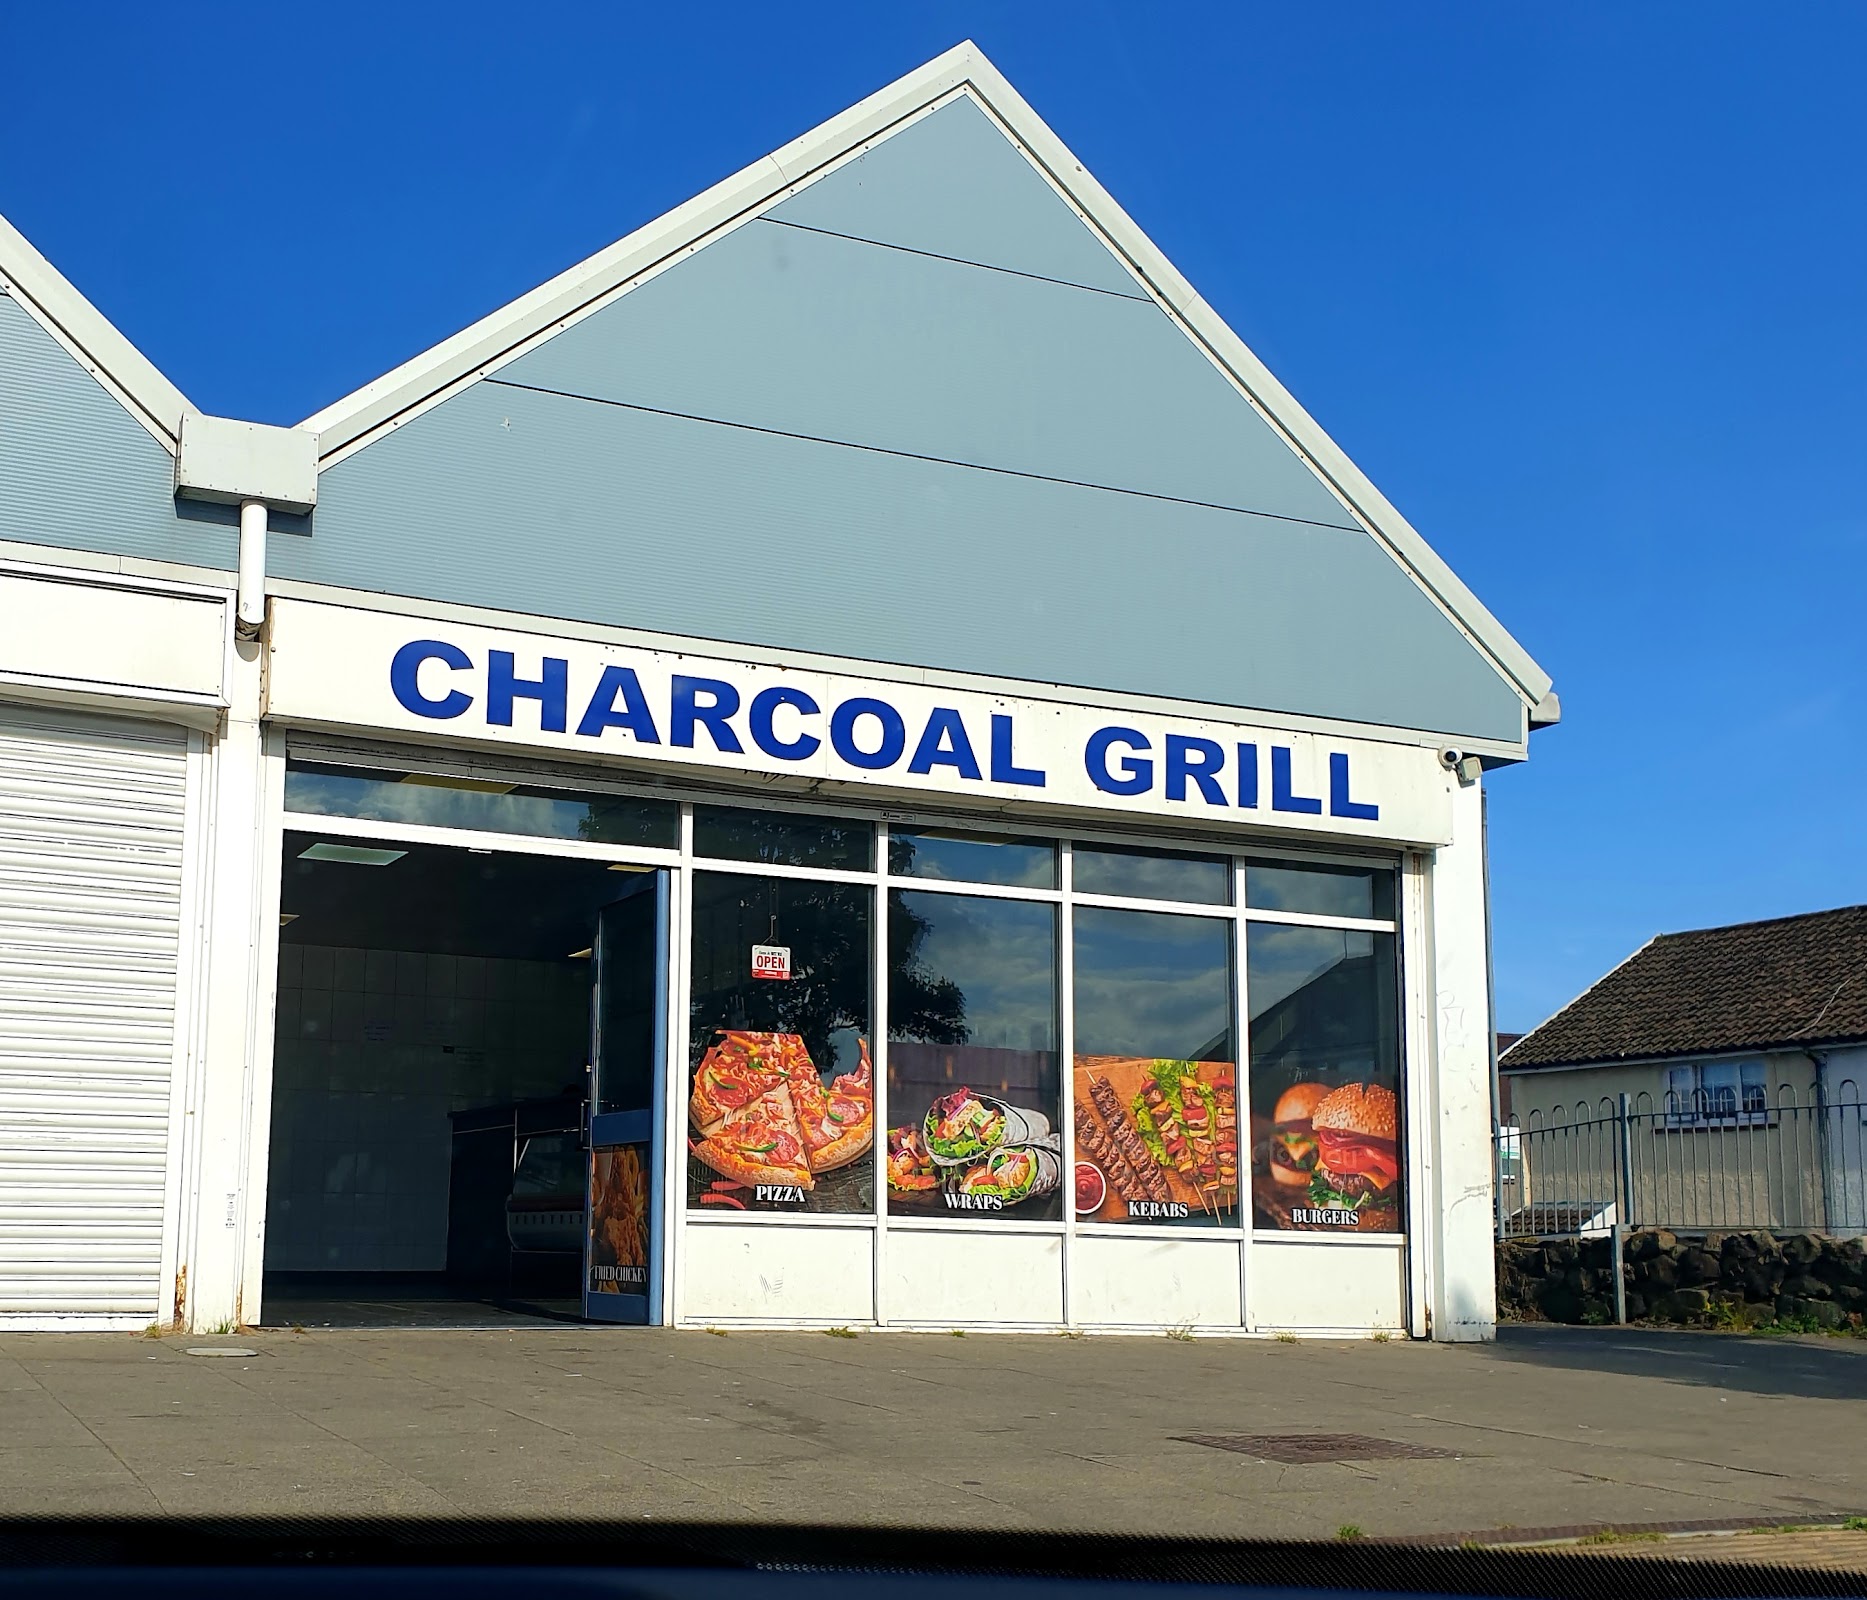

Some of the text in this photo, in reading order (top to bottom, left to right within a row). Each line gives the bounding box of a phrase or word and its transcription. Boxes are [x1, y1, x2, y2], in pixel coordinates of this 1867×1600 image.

[391, 640, 1379, 821] CHARCOAL GRILL
[756, 955, 785, 968] OPEN
[755, 1185, 806, 1203] PIZZA
[943, 1193, 1003, 1211] WRAPS
[1128, 1201, 1189, 1218] KEBABS
[1291, 1208, 1360, 1226] BURGERS
[594, 1265, 615, 1280] FRIED
